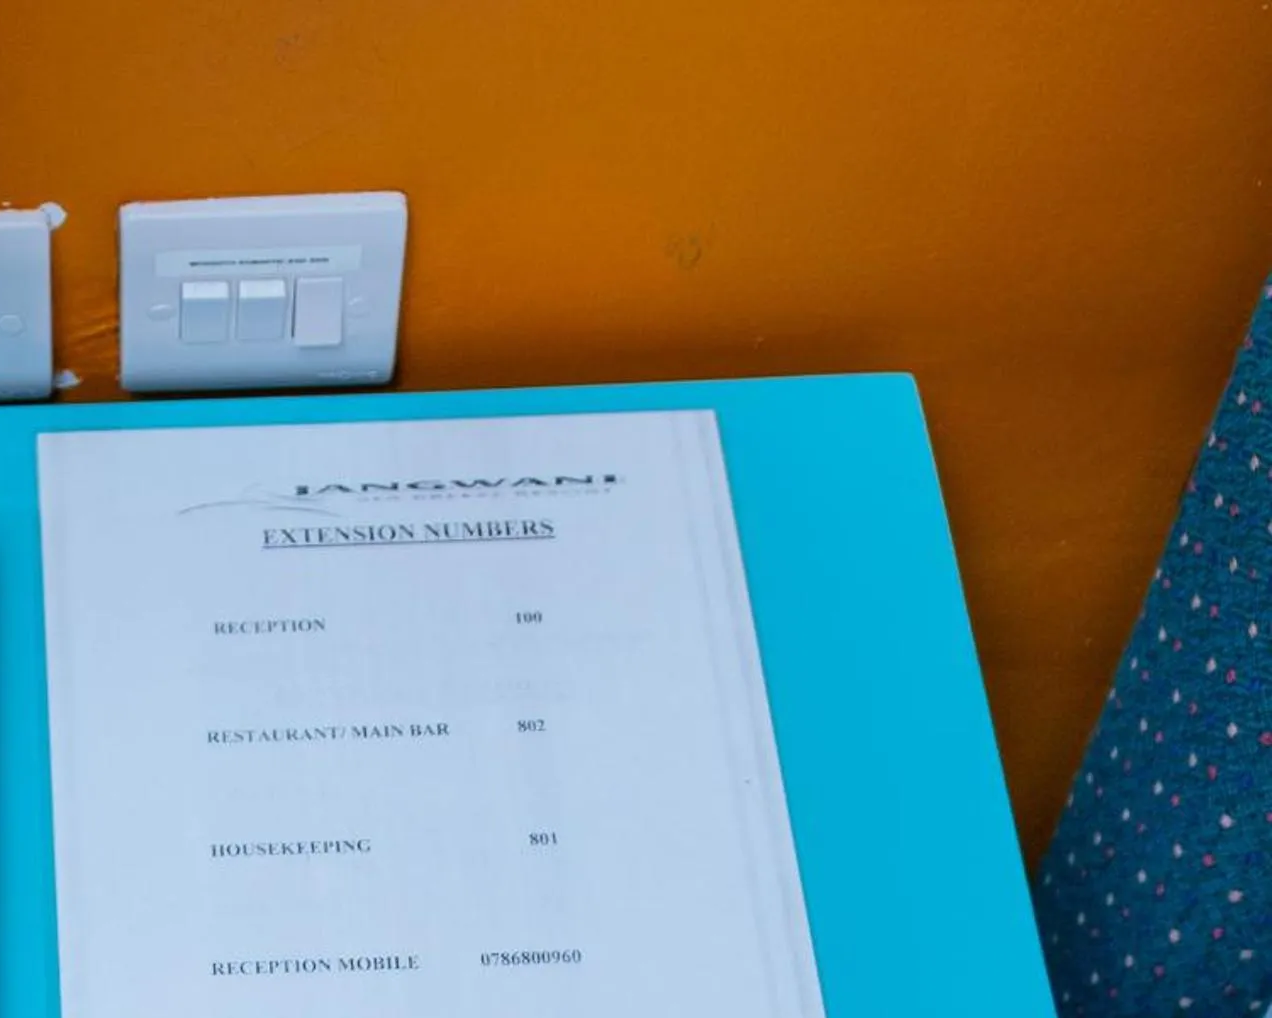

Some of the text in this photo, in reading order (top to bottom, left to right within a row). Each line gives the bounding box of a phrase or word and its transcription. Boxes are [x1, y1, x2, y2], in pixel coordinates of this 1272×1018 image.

[295, 474, 616, 496] JANGWANI
[262, 519, 555, 548] EXTENSION NUMBERS
[214, 611, 543, 635] RECEPTION 100
[207, 719, 546, 744] RESTAURANT/ MAIN BAR 802
[211, 832, 557, 857] HOUSEKEEPING 801
[212, 950, 582, 976] RECEPTION MOBILE 0786800960
